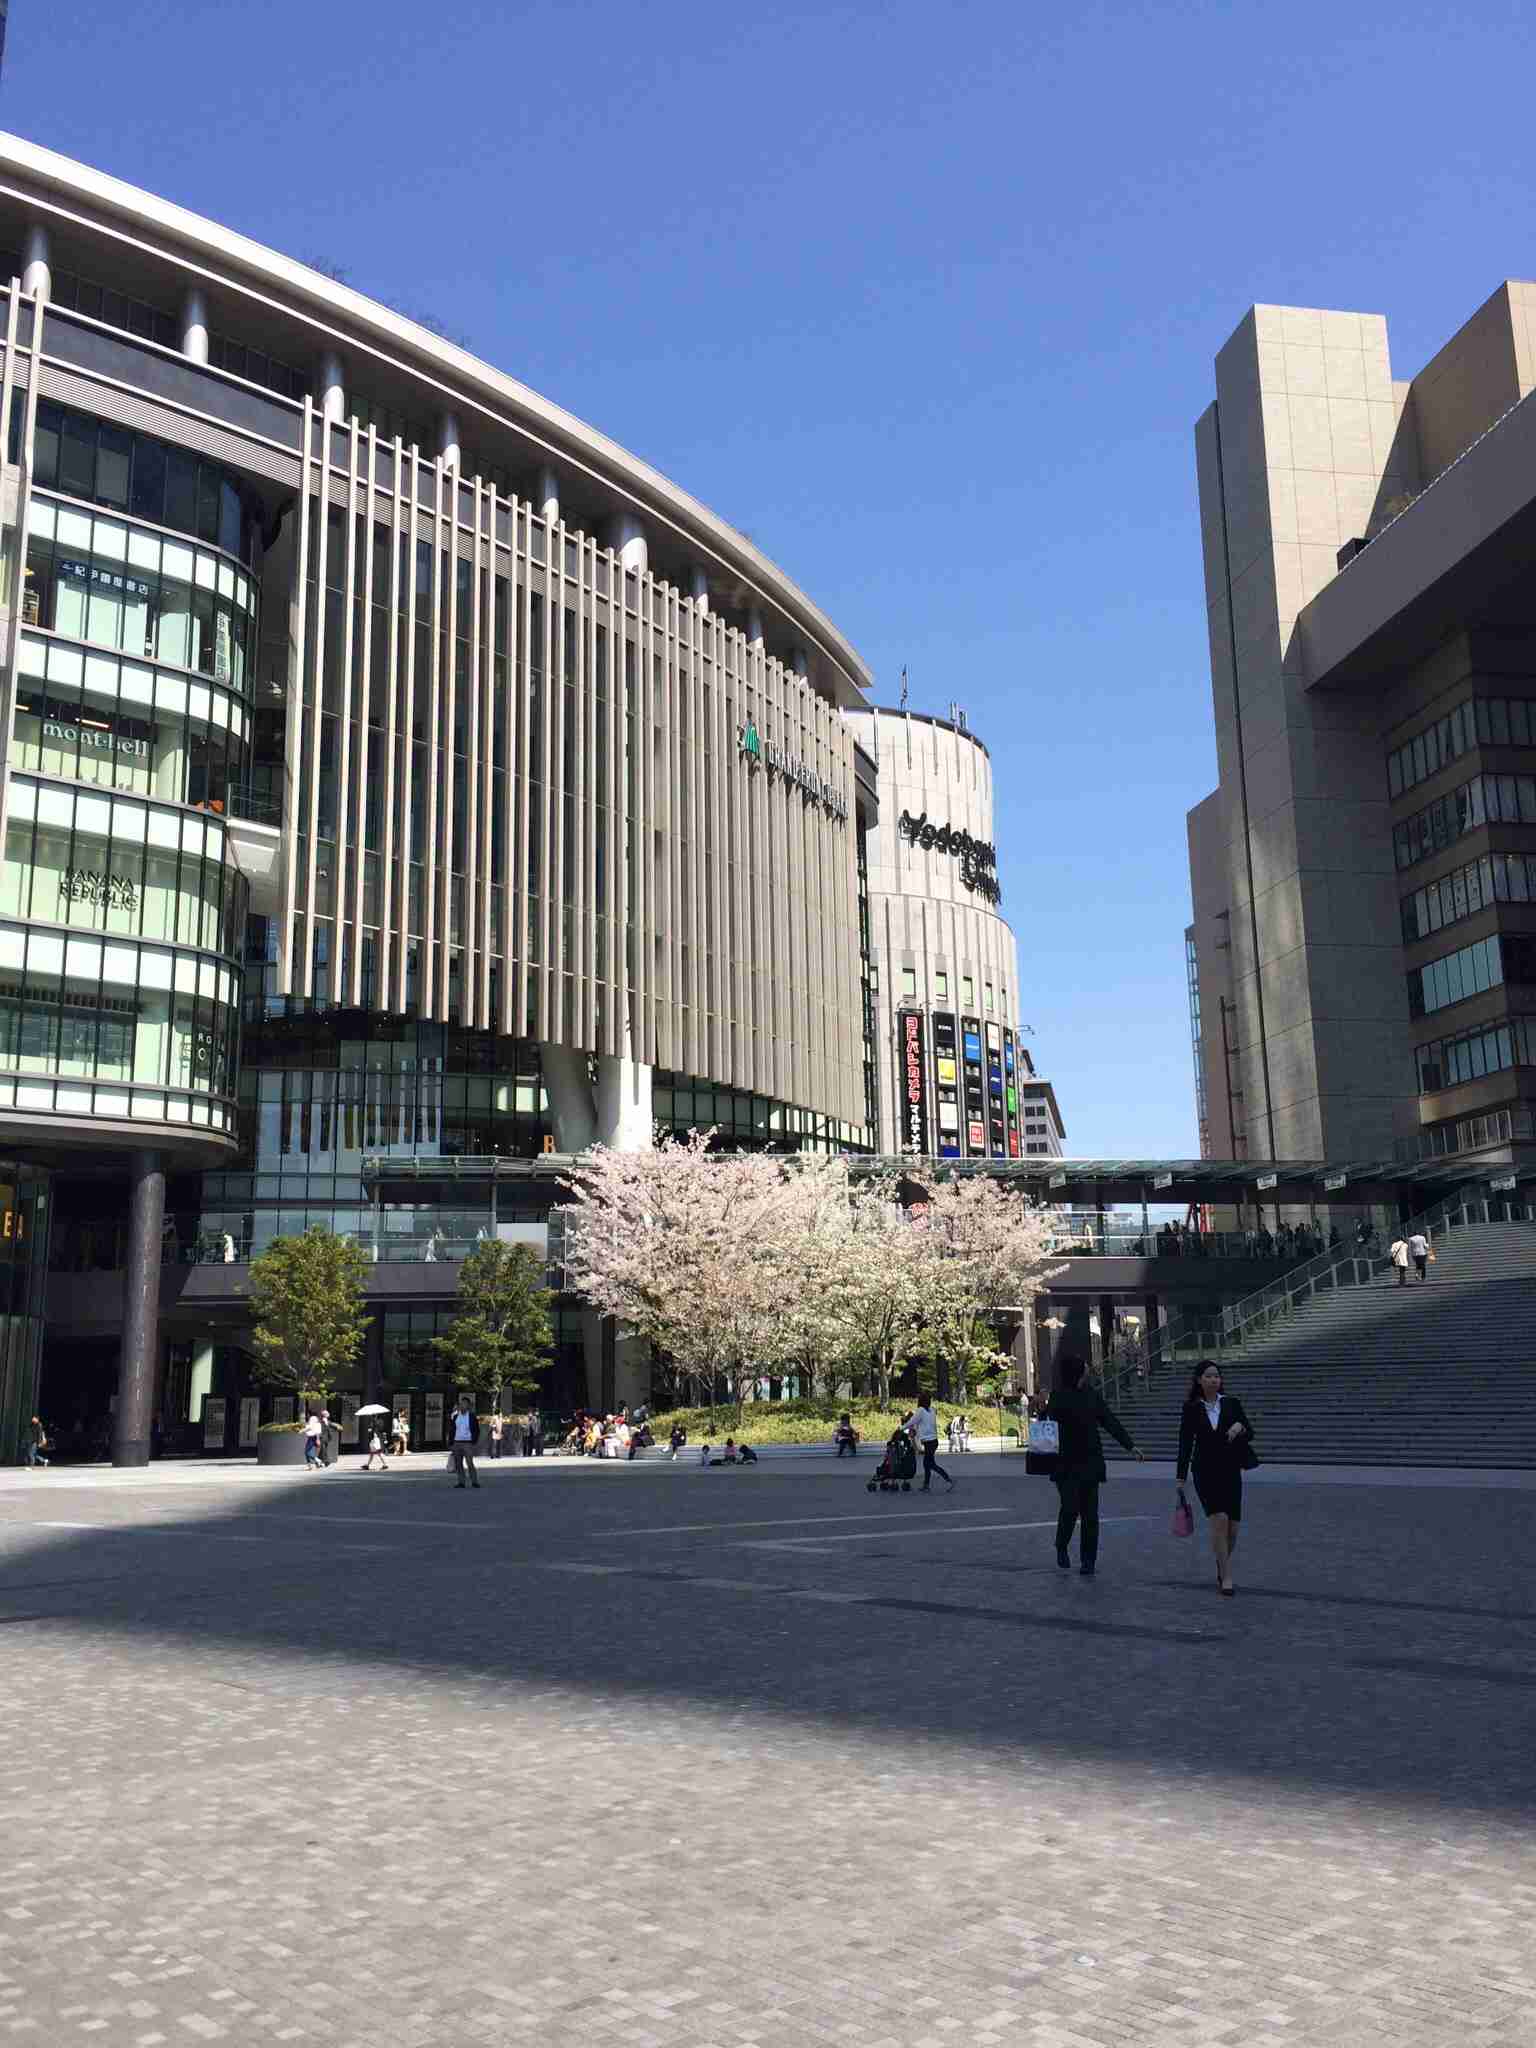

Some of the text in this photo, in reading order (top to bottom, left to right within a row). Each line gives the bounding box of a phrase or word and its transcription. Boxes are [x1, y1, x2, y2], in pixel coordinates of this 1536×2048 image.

[905, 1016, 921, 1103] ヨドバシカメラ
